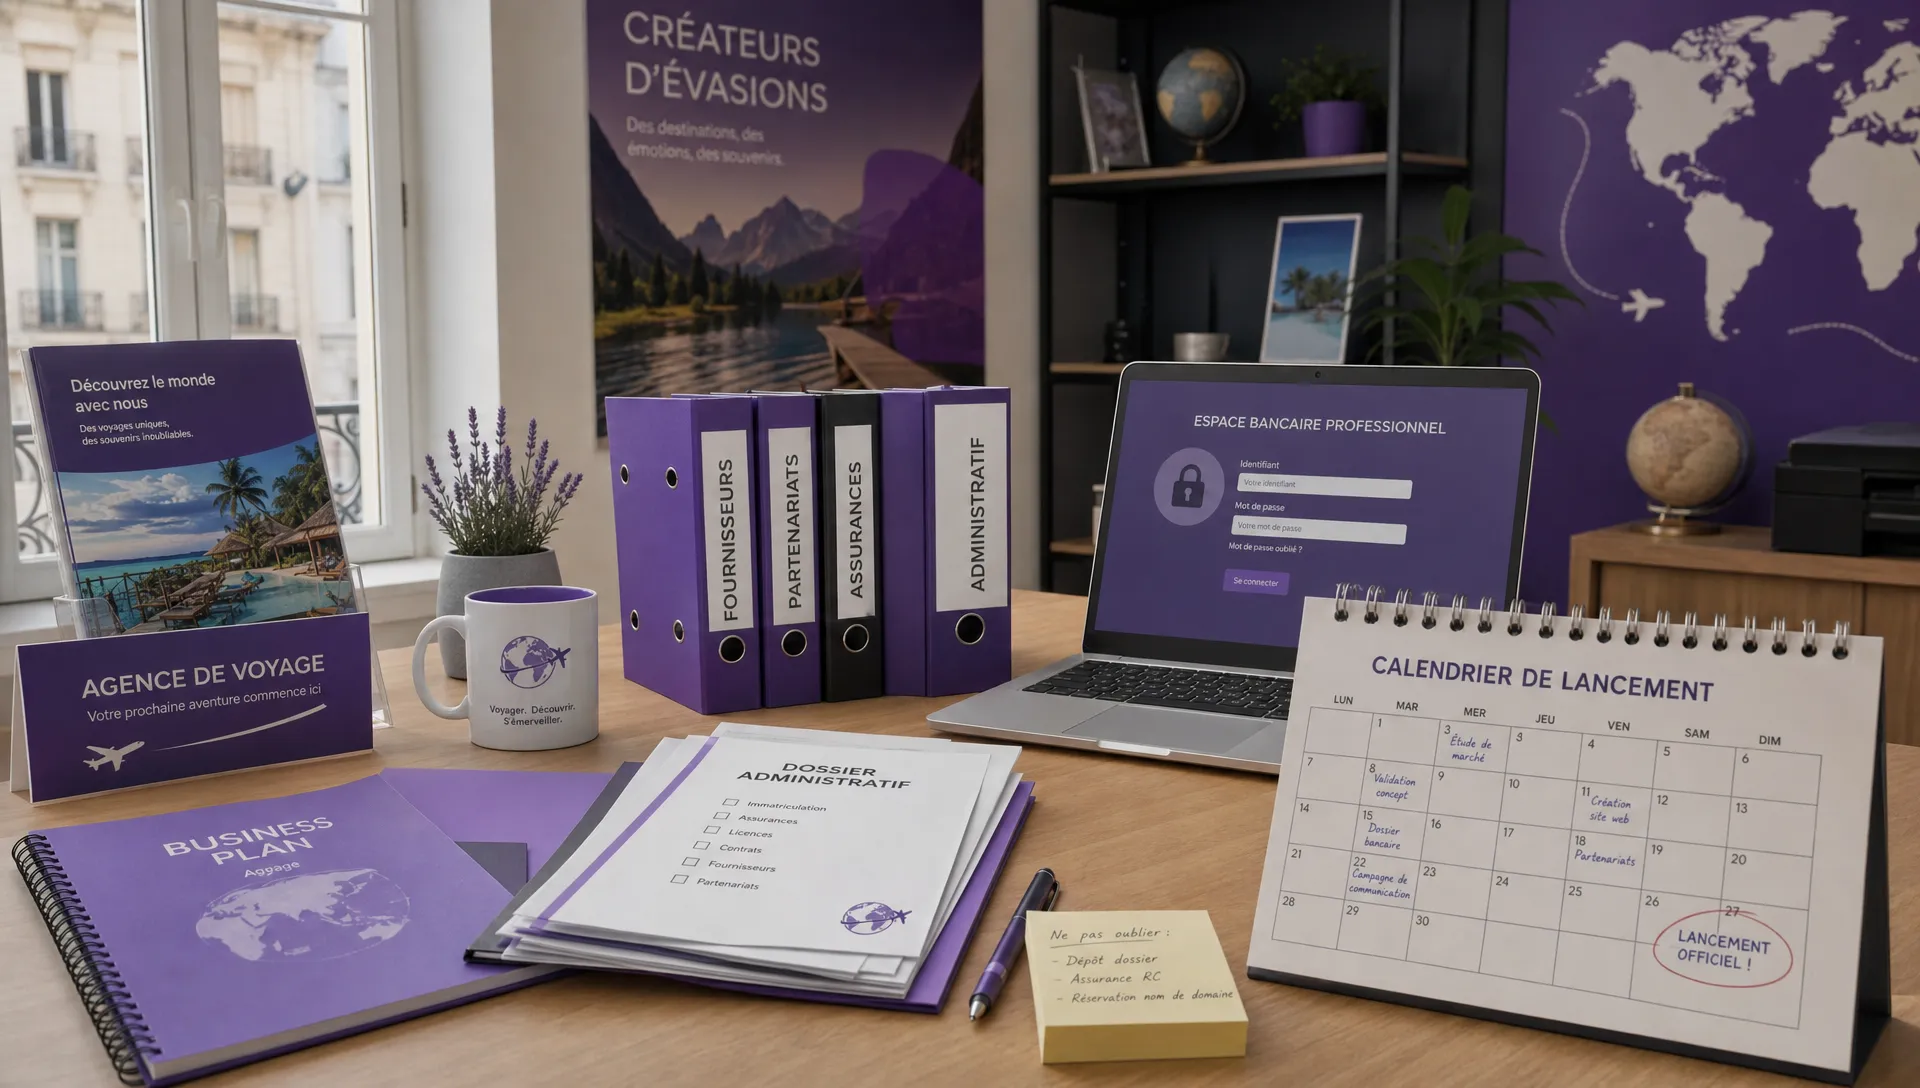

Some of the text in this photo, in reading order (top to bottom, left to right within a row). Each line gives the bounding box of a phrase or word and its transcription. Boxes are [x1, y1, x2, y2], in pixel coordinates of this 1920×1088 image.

[623, 11, 821, 67] CRÉATEURS
[625, 58, 829, 113] D'ÉVASIONS
[626, 115, 764, 142] Des destinations, des
[627, 140, 785, 166] émotions, des souvenirs.
[71, 373, 216, 393] Découvrez le monde
[75, 398, 148, 413] avec nous
[79, 420, 170, 434] Des voyages uniques,
[1193, 415, 1447, 435] ESPACE BANCAIRE PROFESSIONNEL
[82, 430, 194, 446] des souvenirs inoubliables.
[1240, 460, 1280, 469] Identifiant
[1262, 479, 1296, 488] identifiant
[1235, 501, 1250, 510] Mot
[1251, 502, 1262, 510] de
[970, 437, 985, 592] ADMINISTRATIF
[786, 454, 802, 609] PARTENARIATS
[848, 461, 863, 599] ASSURANCES
[1238, 522, 1256, 530] Votre
[1272, 523, 1281, 531] de
[719, 458, 739, 622] FOURNISSEURS
[1228, 542, 1242, 550] Mot
[1233, 577, 1279, 587] Se connecter
[82, 654, 325, 699] AGENCE DE VOYAGE
[1372, 655, 1714, 702] CALENDRIER DE LANCEMENT
[88, 683, 322, 723] Votre prochaine aventure commence ici
[489, 703, 575, 716] Voyager. Découvrir.
[1333, 695, 1781, 746] LUN MAR MER JEU VEN SAM DIM
[1444, 725, 1451, 735] 3
[1588, 739, 1595, 749] 4
[1663, 746, 1670, 757] 5
[1742, 753, 1749, 764] 6
[1450, 733, 1492, 749] Étude de
[1452, 752, 1485, 763] marché
[782, 763, 877, 776] DOSSIER
[737, 771, 911, 789] ADMINISTRATIF
[1307, 757, 1748, 814] 7 8 9 10 11 12 13
[1374, 773, 1416, 787] Validation
[1376, 789, 1409, 802] concept
[1591, 795, 1631, 809] Création
[747, 801, 827, 812] Immatriculation
[738, 814, 799, 825] Assurances
[1589, 812, 1630, 824] site web
[163, 816, 334, 857] BUSINESS
[728, 829, 773, 839] Licences
[1300, 803, 1747, 865] 14 15 16 17 18 19 20
[1368, 823, 1400, 835] Dossier
[719, 844, 763, 854] Contrats
[1364, 836, 1401, 850] bancaire
[211, 837, 313, 866] PLAN
[1574, 849, 1636, 866] Partenariats
[708, 860, 776, 873] Fournisseurs
[697, 878, 759, 890] Partenariats
[1291, 849, 1740, 917] 21 22 23 24 25 26 27
[1352, 868, 1408, 885] Campagne de
[1349, 884, 1411, 899] communication
[1283, 896, 1429, 926] 28 29 30
[1050, 930, 1068, 940] Ne
[1080, 931, 1103, 943] pas
[1115, 927, 1161, 939] oublier
[1678, 929, 1771, 955] LANCEMENT
[1066, 955, 1104, 969] Dépôt
[1115, 954, 1158, 964] dossier
[1677, 949, 1741, 970] OFFICIEL
[1071, 973, 1132, 984] Assurance
[1143, 971, 1161, 981] RC
[1072, 993, 1136, 1003] Réservation
[1144, 993, 1165, 1001] nom
[1173, 990, 1185, 999] de
[1191, 990, 1234, 999] domaine
